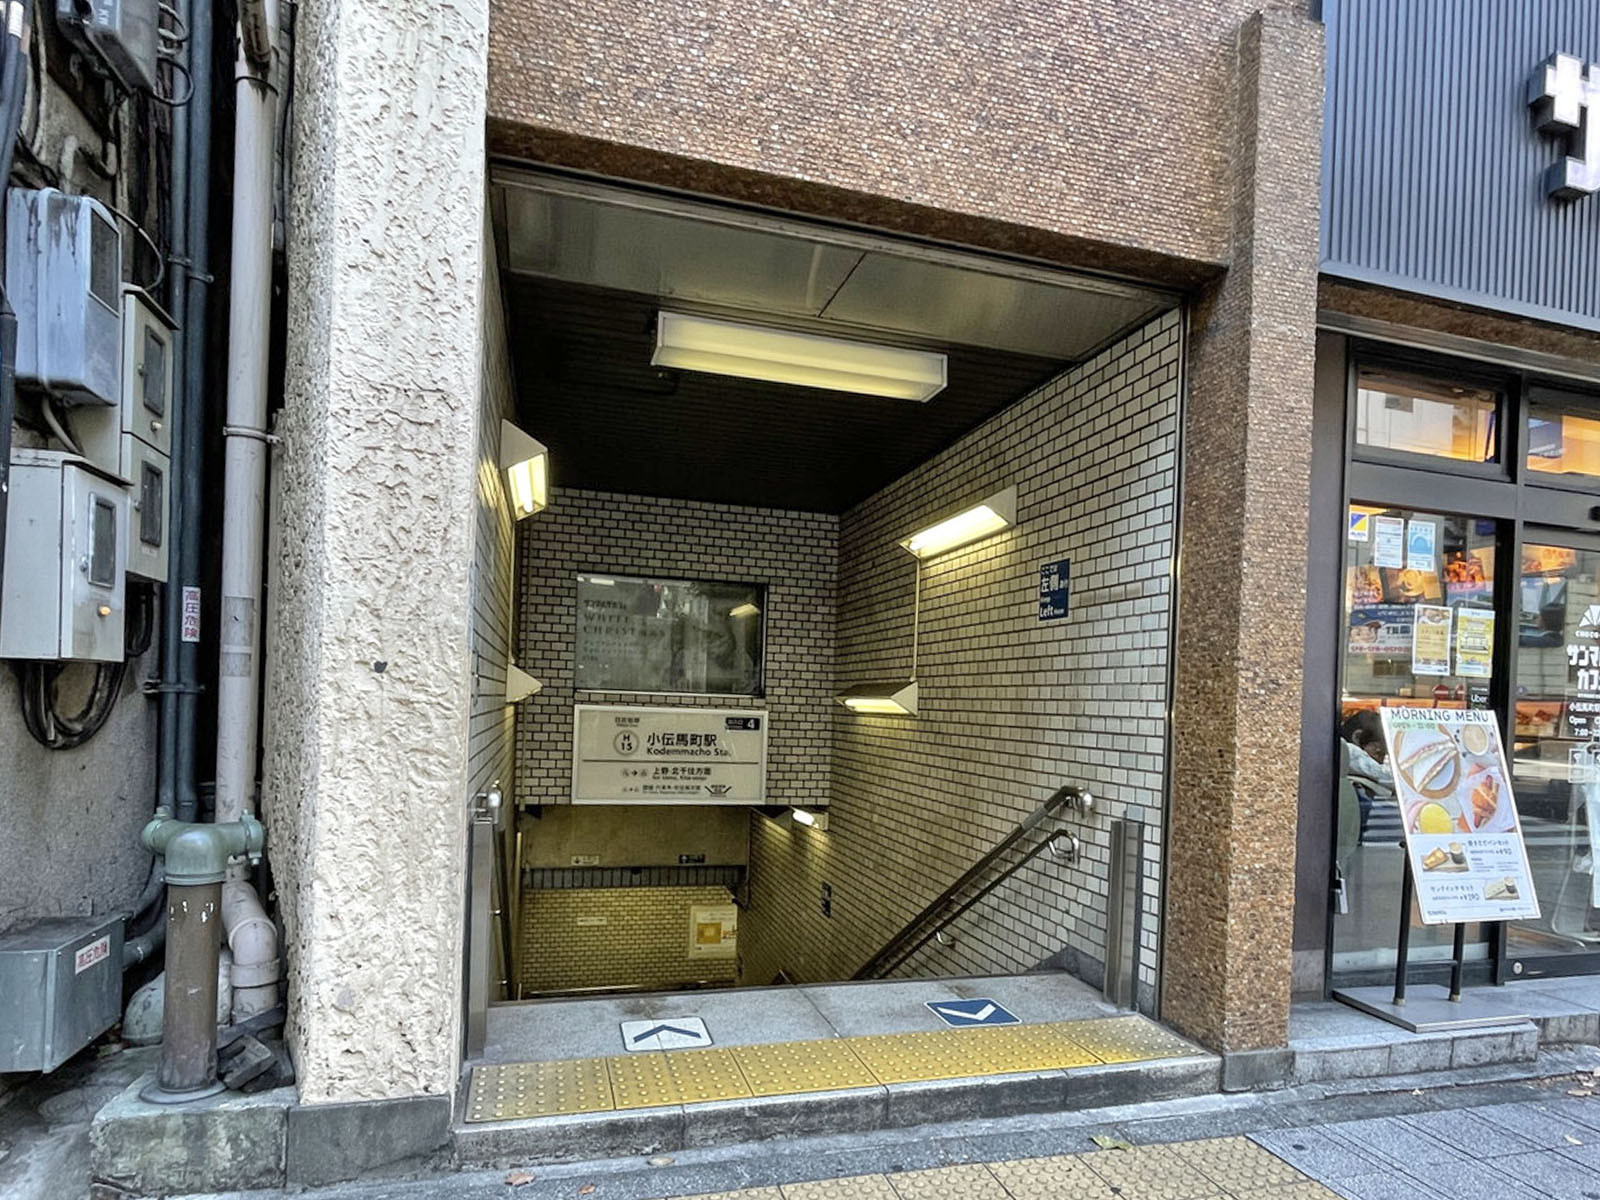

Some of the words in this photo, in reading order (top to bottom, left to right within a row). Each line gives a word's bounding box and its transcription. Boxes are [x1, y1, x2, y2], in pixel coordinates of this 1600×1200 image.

[184, 590, 200, 638] 高圧危険
[1566, 644, 1600, 667] サンマ
[1577, 668, 1600, 690] カフ
[1471, 693, 1488, 702] Uber
[1390, 708, 1451, 721] MORNING
[1455, 710, 1489, 722] MENU
[747, 719, 755, 729] 4
[647, 732, 717, 746] 小伝馬町駅
[621, 742, 633, 751] 15
[646, 748, 711, 757] Kodemmacho
